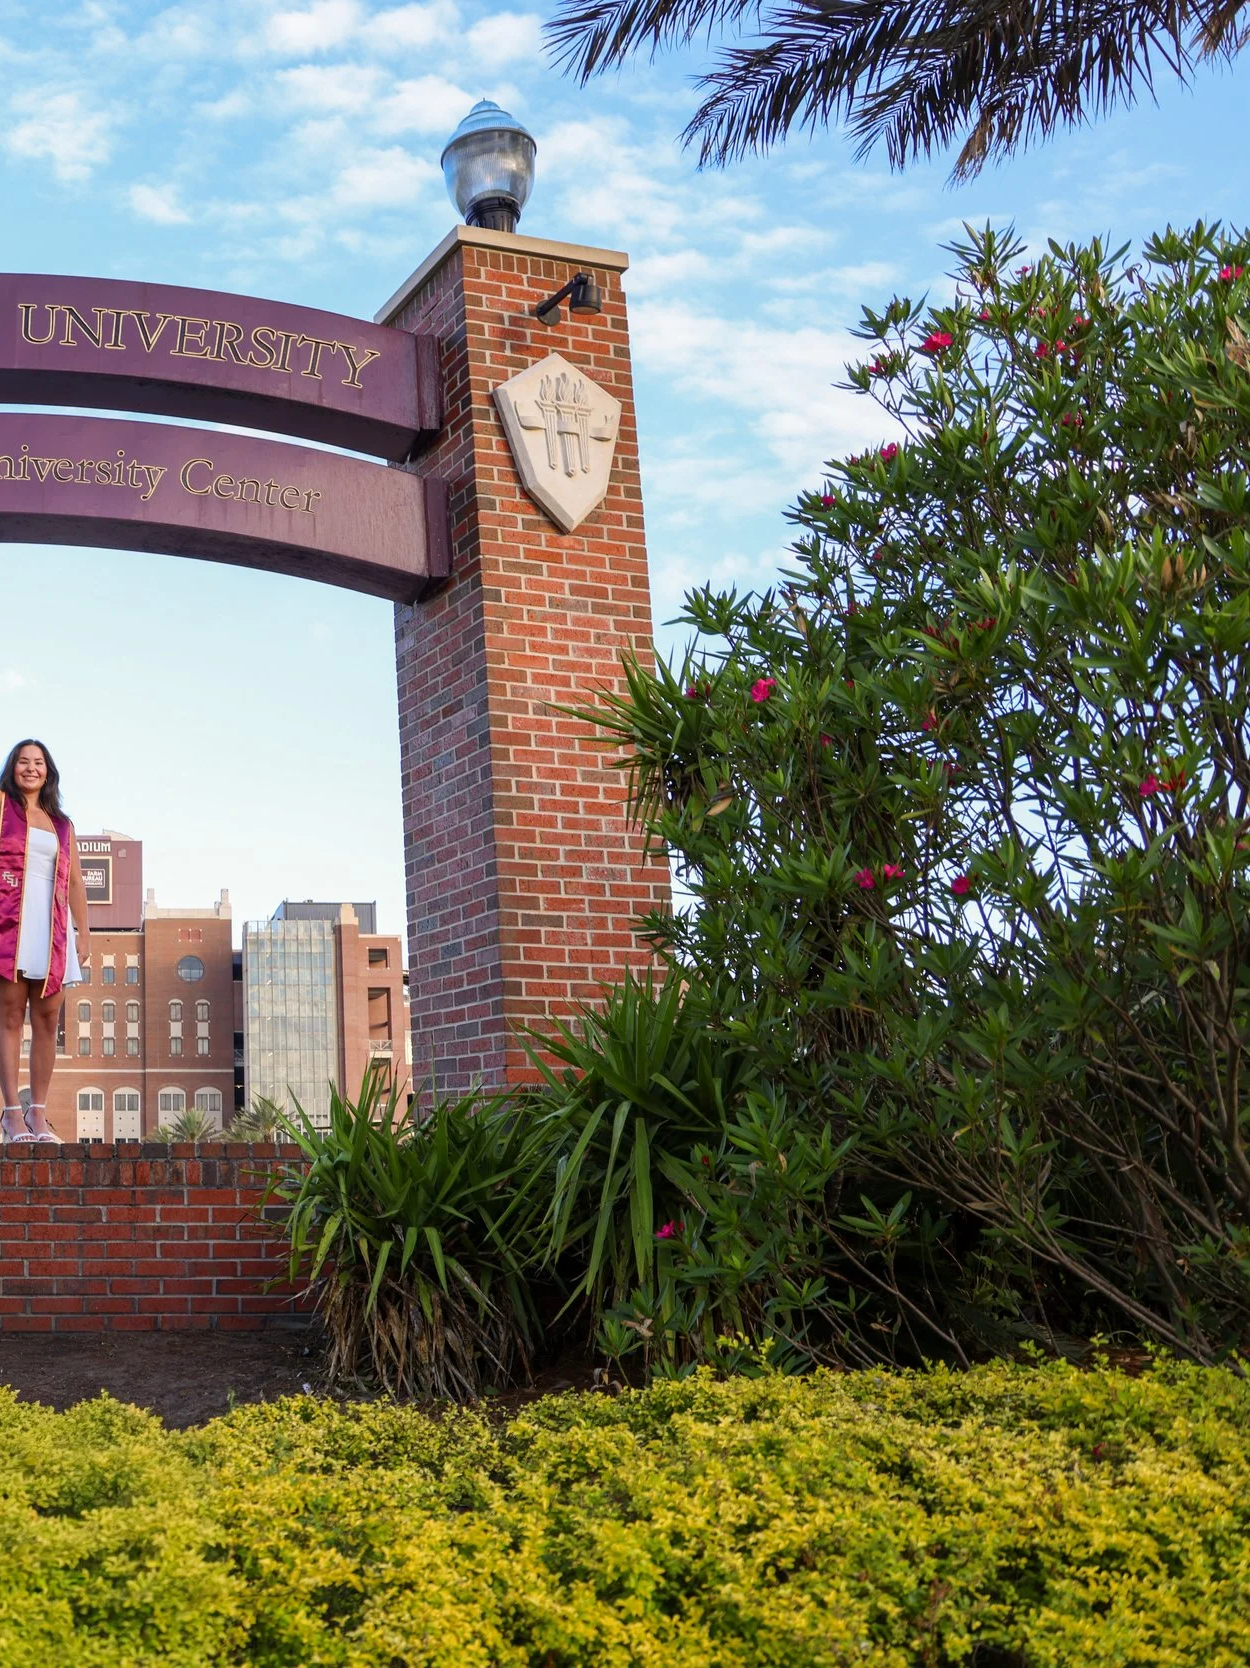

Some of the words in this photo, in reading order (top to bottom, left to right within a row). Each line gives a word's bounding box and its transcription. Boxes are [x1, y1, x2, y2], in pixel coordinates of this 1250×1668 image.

[18, 303, 381, 389] UNIVERSITY
[179, 458, 322, 514] Center
[76, 841, 111, 853] ADIUM
[1, 871, 19, 888] FSU
